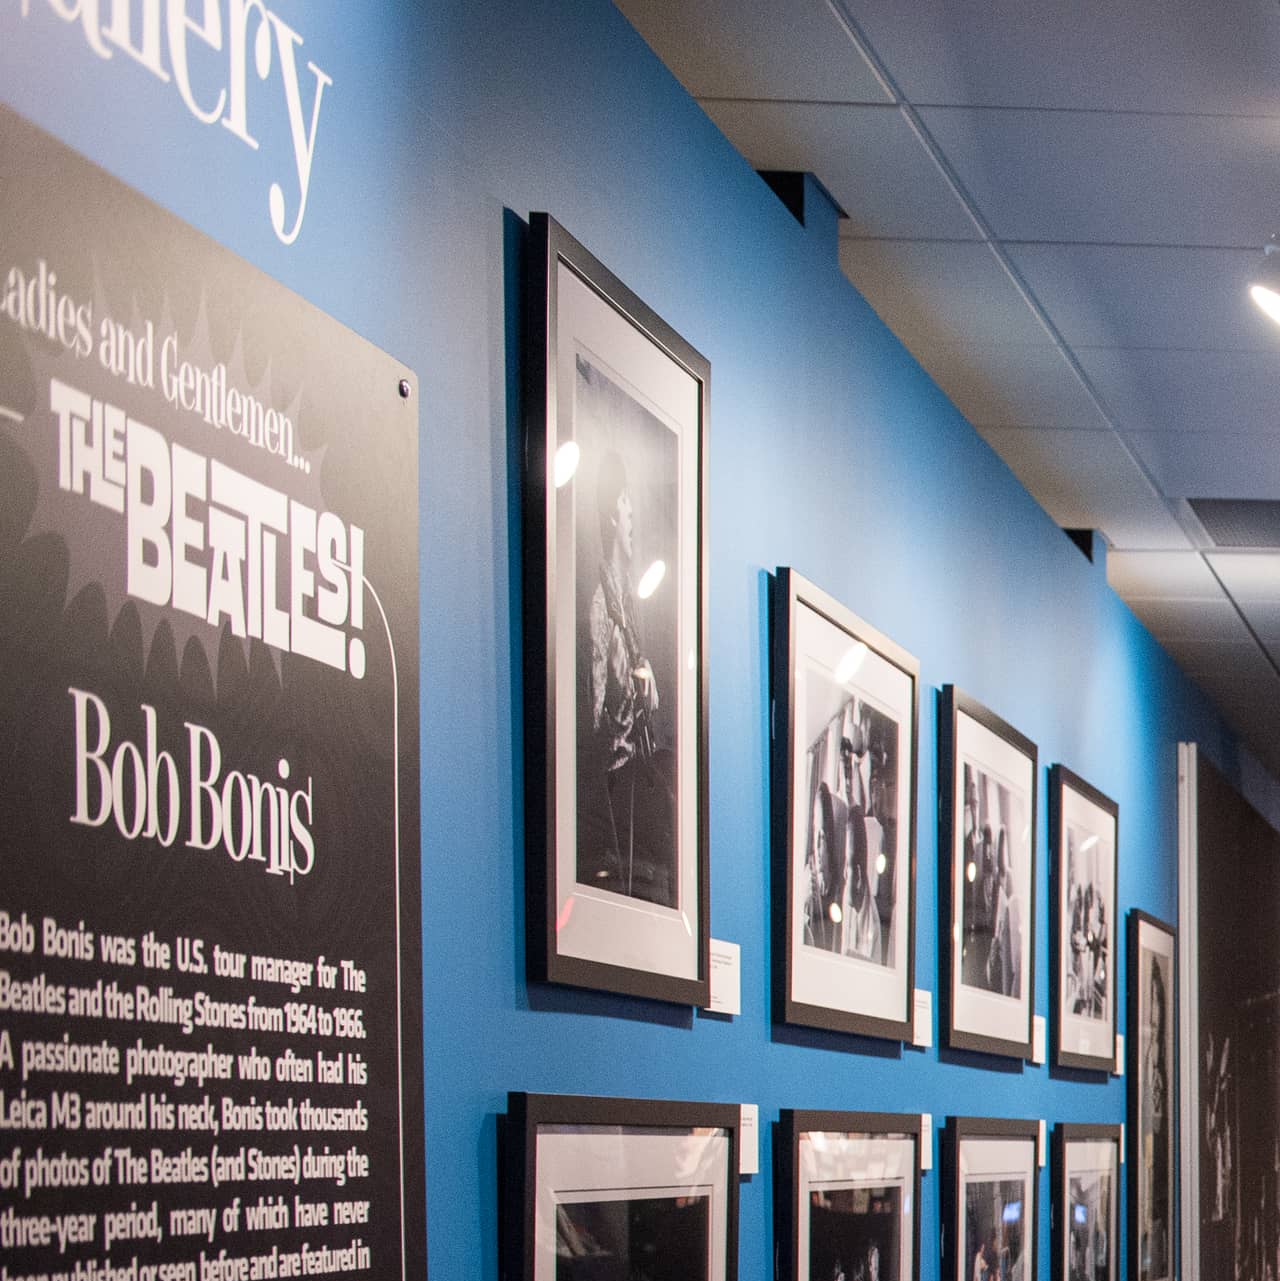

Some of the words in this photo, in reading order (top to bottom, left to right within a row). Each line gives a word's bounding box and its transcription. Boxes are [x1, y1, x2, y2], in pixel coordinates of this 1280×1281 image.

[100, 318, 154, 388] and
[162, 330, 311, 475] Gentlemen...
[50, 379, 127, 514] THE
[126, 415, 367, 681] BEATLES!
[68, 687, 181, 848] Bob
[185, 721, 315, 886] Bonis
[44, 918, 93, 960] Bonis
[101, 935, 135, 965] was
[142, 932, 170, 969] the
[177, 937, 207, 973] U.S.
[214, 945, 246, 978] tour
[252, 956, 313, 993] manager
[317, 956, 337, 988] for
[341, 960, 366, 992] The
[69, 980, 102, 1017] and
[105, 982, 133, 1020] the
[137, 986, 192, 1034] Rolling
[195, 992, 246, 1029] Stones
[248, 996, 283, 1031] from
[284, 1003, 317, 1034] 1964
[318, 1008, 332, 1035] to
[333, 1008, 366, 1038] 1966.
[23, 1034, 119, 1080] passionate
[127, 1039, 233, 1087] photographer
[239, 1047, 270, 1080] who
[276, 1049, 312, 1082] often
[318, 1051, 343, 1083] had
[348, 1054, 367, 1084] his
[53, 1092, 80, 1129] M3
[86, 1093, 146, 1129] around
[151, 1094, 174, 1129] his
[179, 1096, 218, 1135] neck,
[223, 1097, 263, 1130] Bonis
[265, 1098, 298, 1130] took
[300, 1099, 368, 1130] thousands
[0, 1148, 19, 1188] of
[26, 1148, 88, 1197] photos
[93, 1147, 111, 1185] of
[115, 1148, 147, 1184] The
[151, 1148, 208, 1183] Beatles
[212, 1146, 245, 1187] (and
[248, 1145, 300, 1184] Stones)
[303, 1147, 345, 1186] during
[347, 1147, 368, 1177] the
[1, 1208, 96, 1253] three-year
[105, 1201, 161, 1250] period,
[171, 1209, 216, 1242] many
[223, 1198, 239, 1232] of
[246, 1196, 288, 1230] which
[295, 1196, 328, 1227] have
[334, 1201, 369, 1224] never
[251, 1246, 277, 1280] and
[279, 1253, 300, 1277] are
[302, 1242, 356, 1274] featured
[358, 1241, 370, 1269] in
